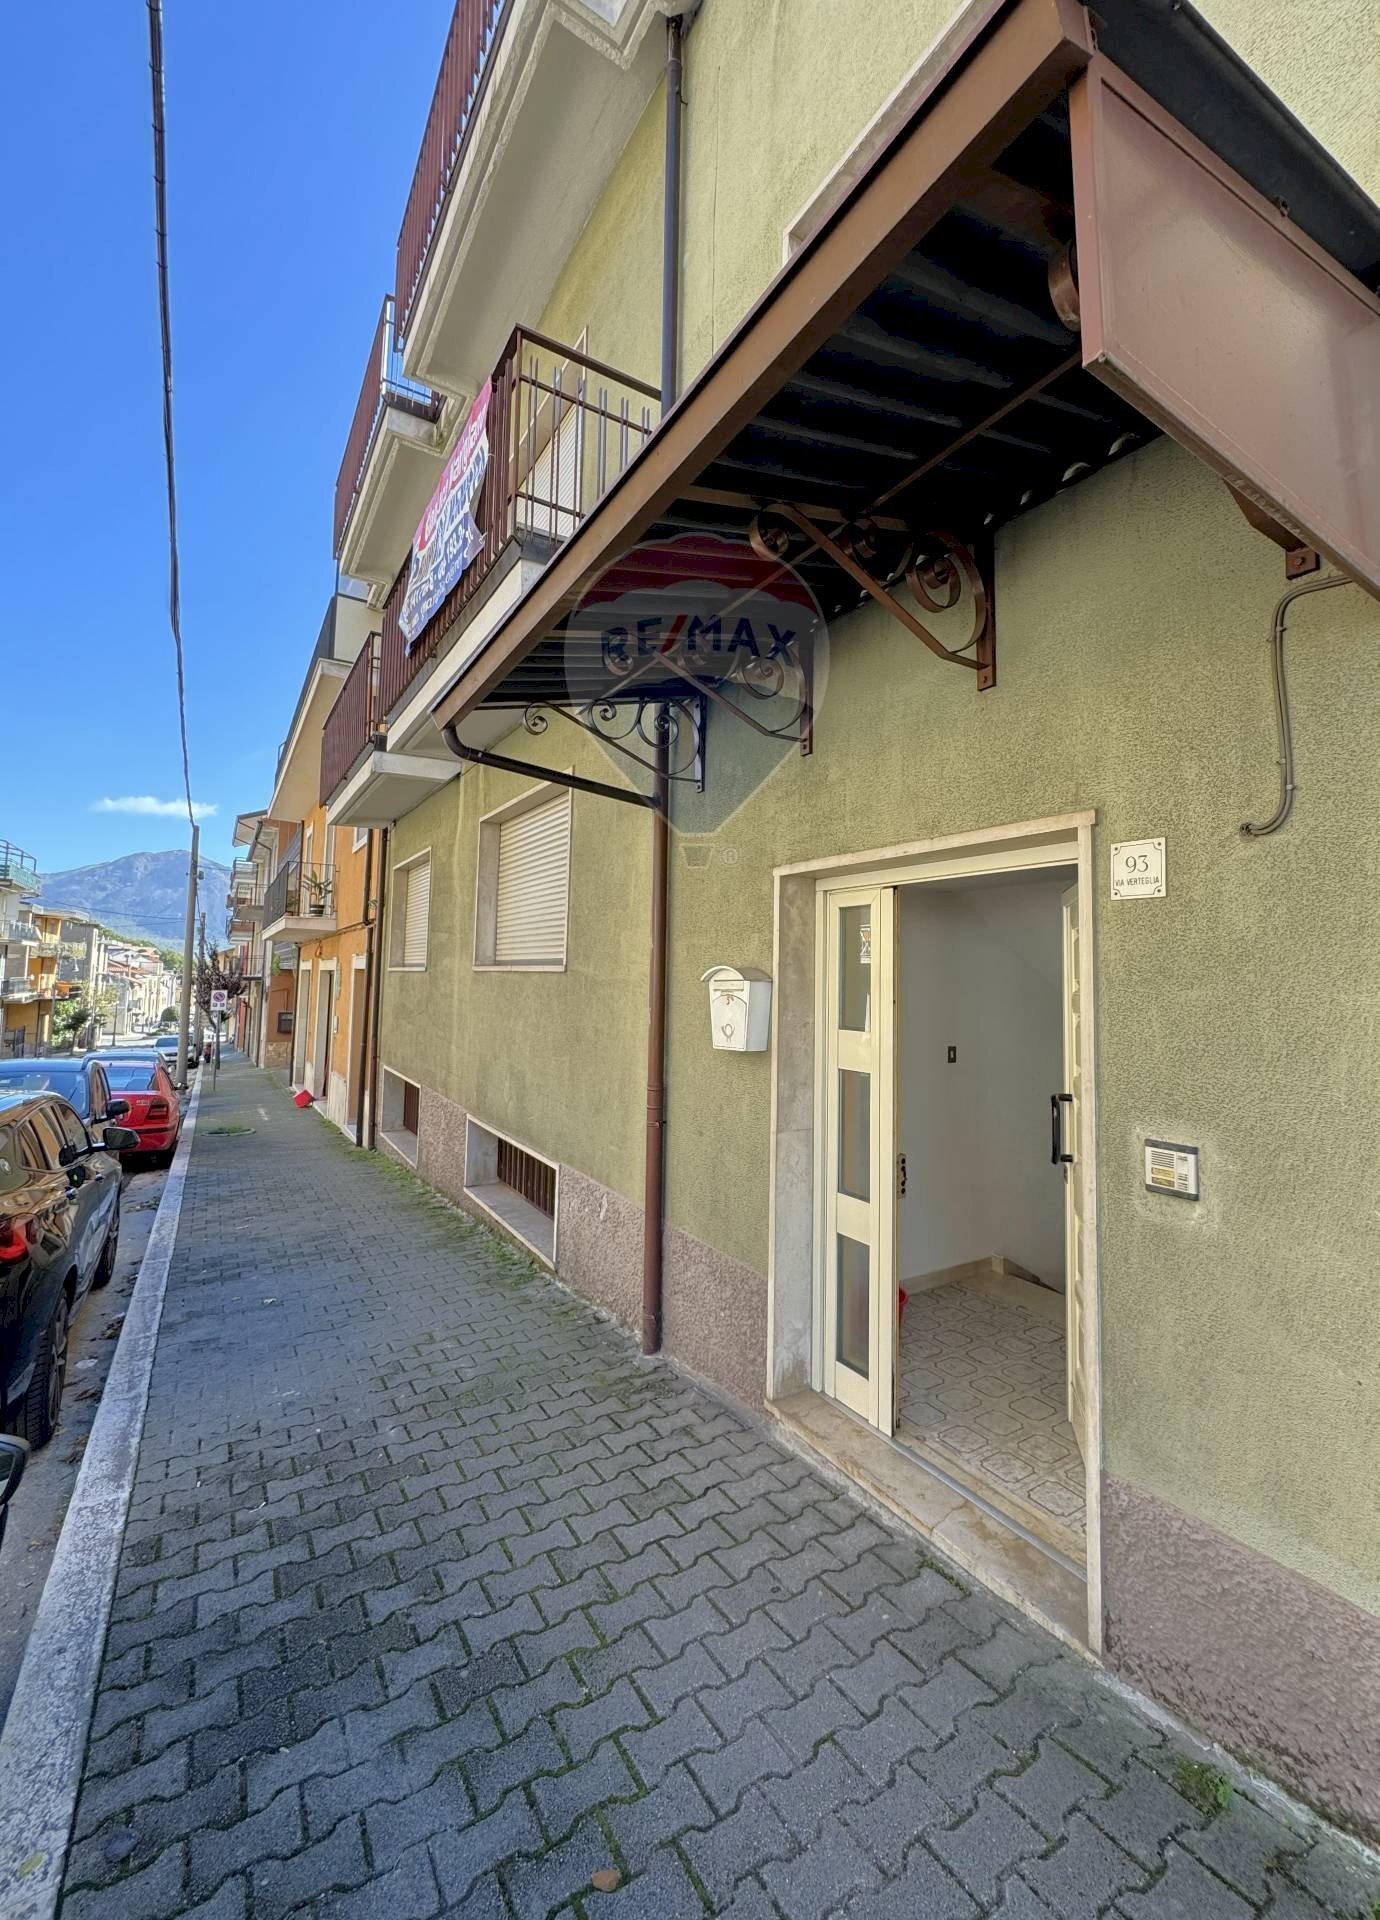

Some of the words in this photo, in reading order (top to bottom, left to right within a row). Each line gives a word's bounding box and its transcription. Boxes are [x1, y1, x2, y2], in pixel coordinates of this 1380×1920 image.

[1125, 854, 1149, 873] 93
[1115, 879, 1125, 887] VIA
[1126, 876, 1160, 886] VERTEGLIA
